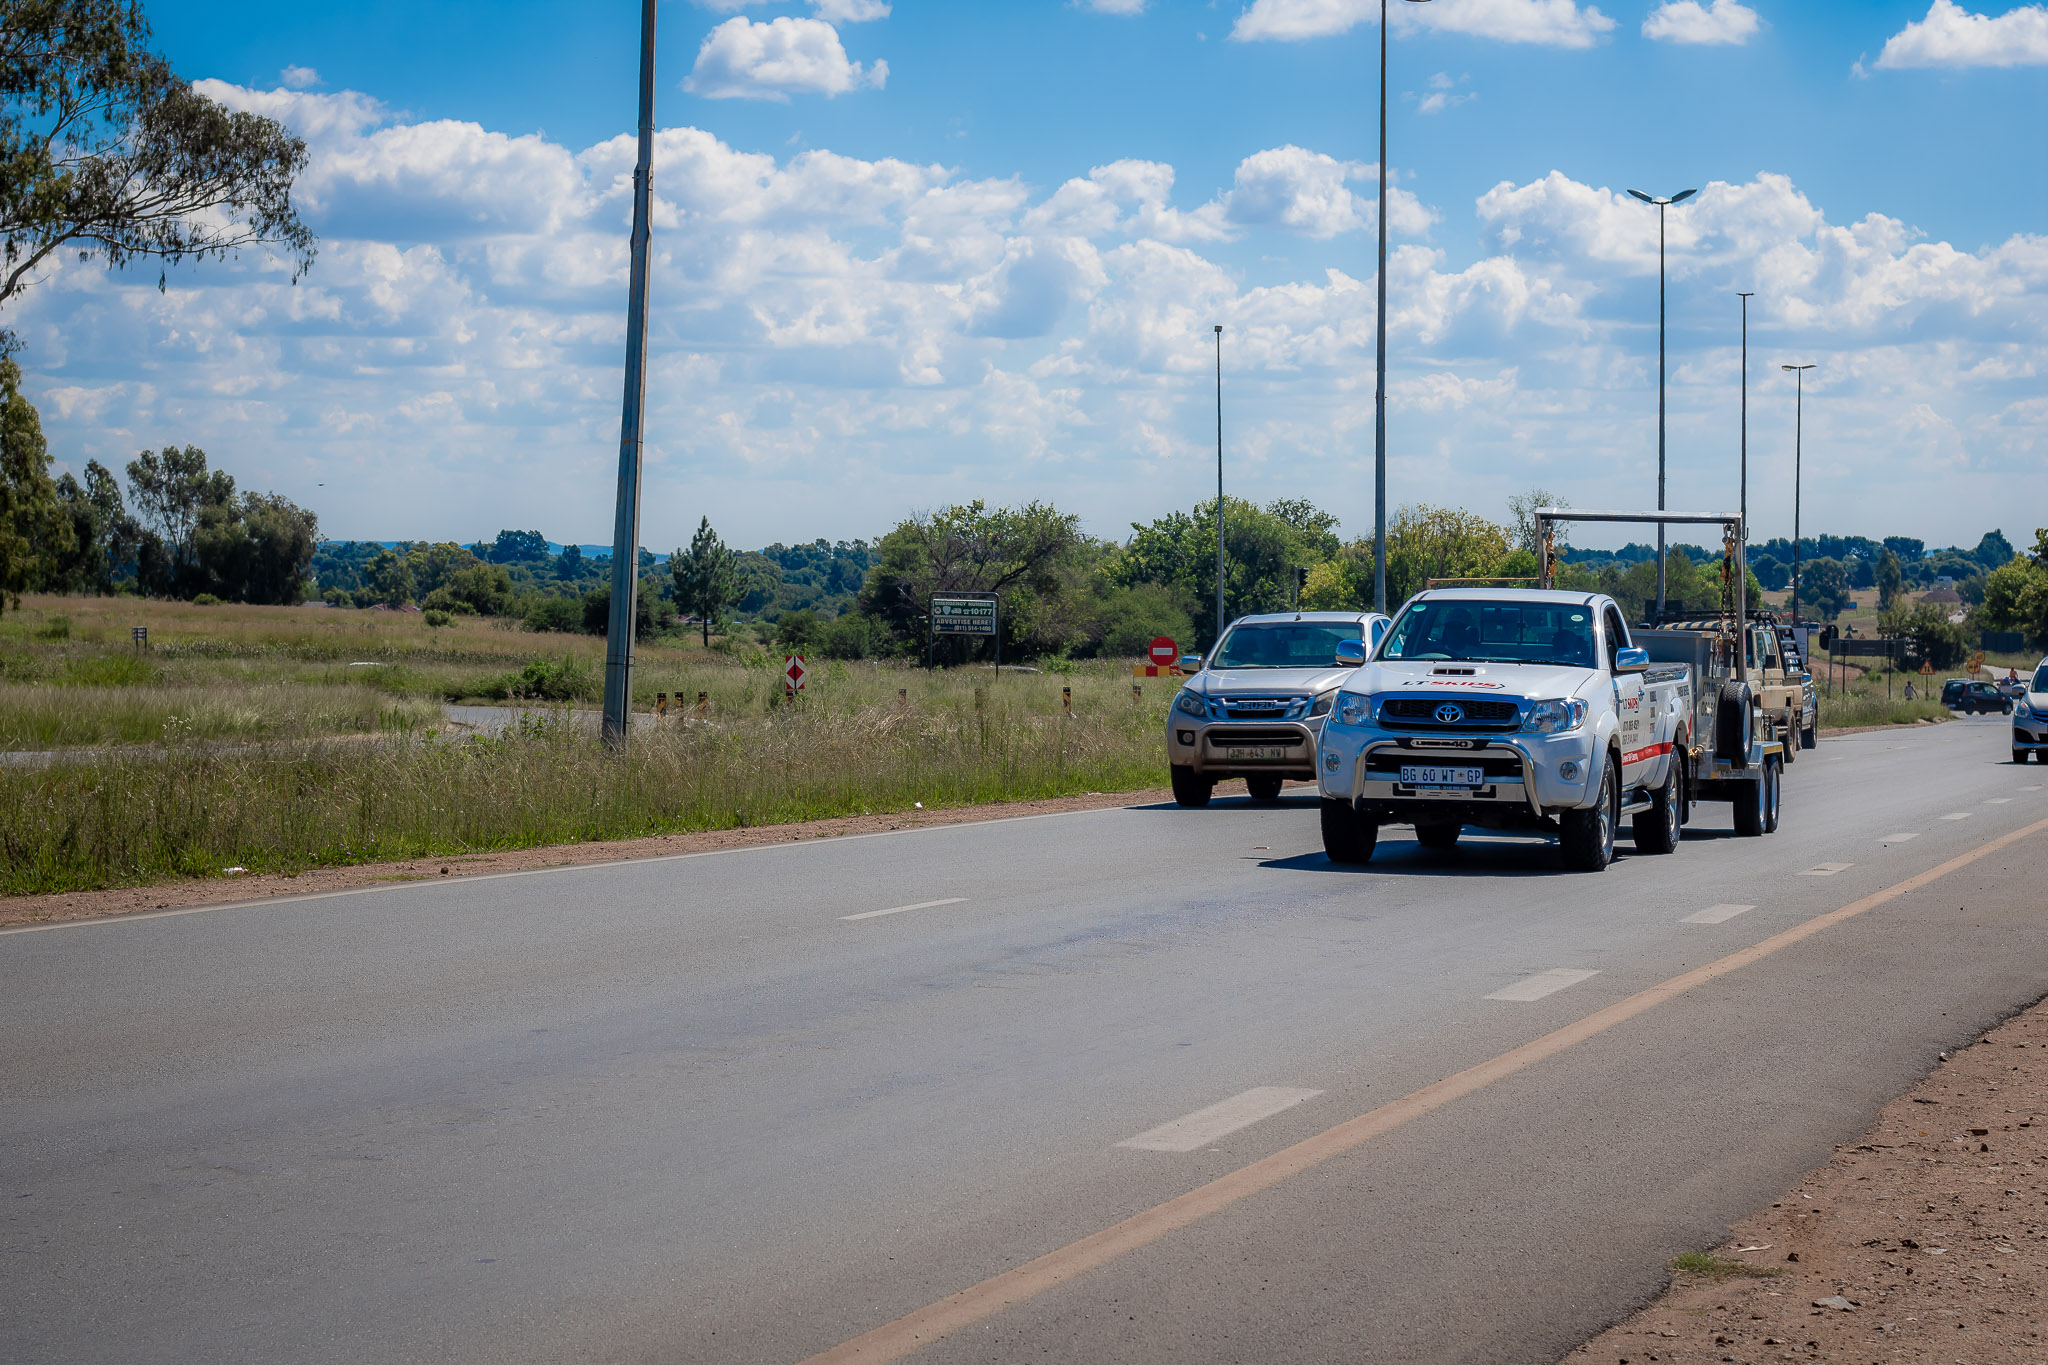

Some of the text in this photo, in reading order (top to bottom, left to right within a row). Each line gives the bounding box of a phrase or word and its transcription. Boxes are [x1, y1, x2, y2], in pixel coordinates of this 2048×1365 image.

[1249, 748, 1265, 758] 643
[1270, 748, 1281, 758] NW
[1402, 768, 1481, 782] BG 60 WT GP
